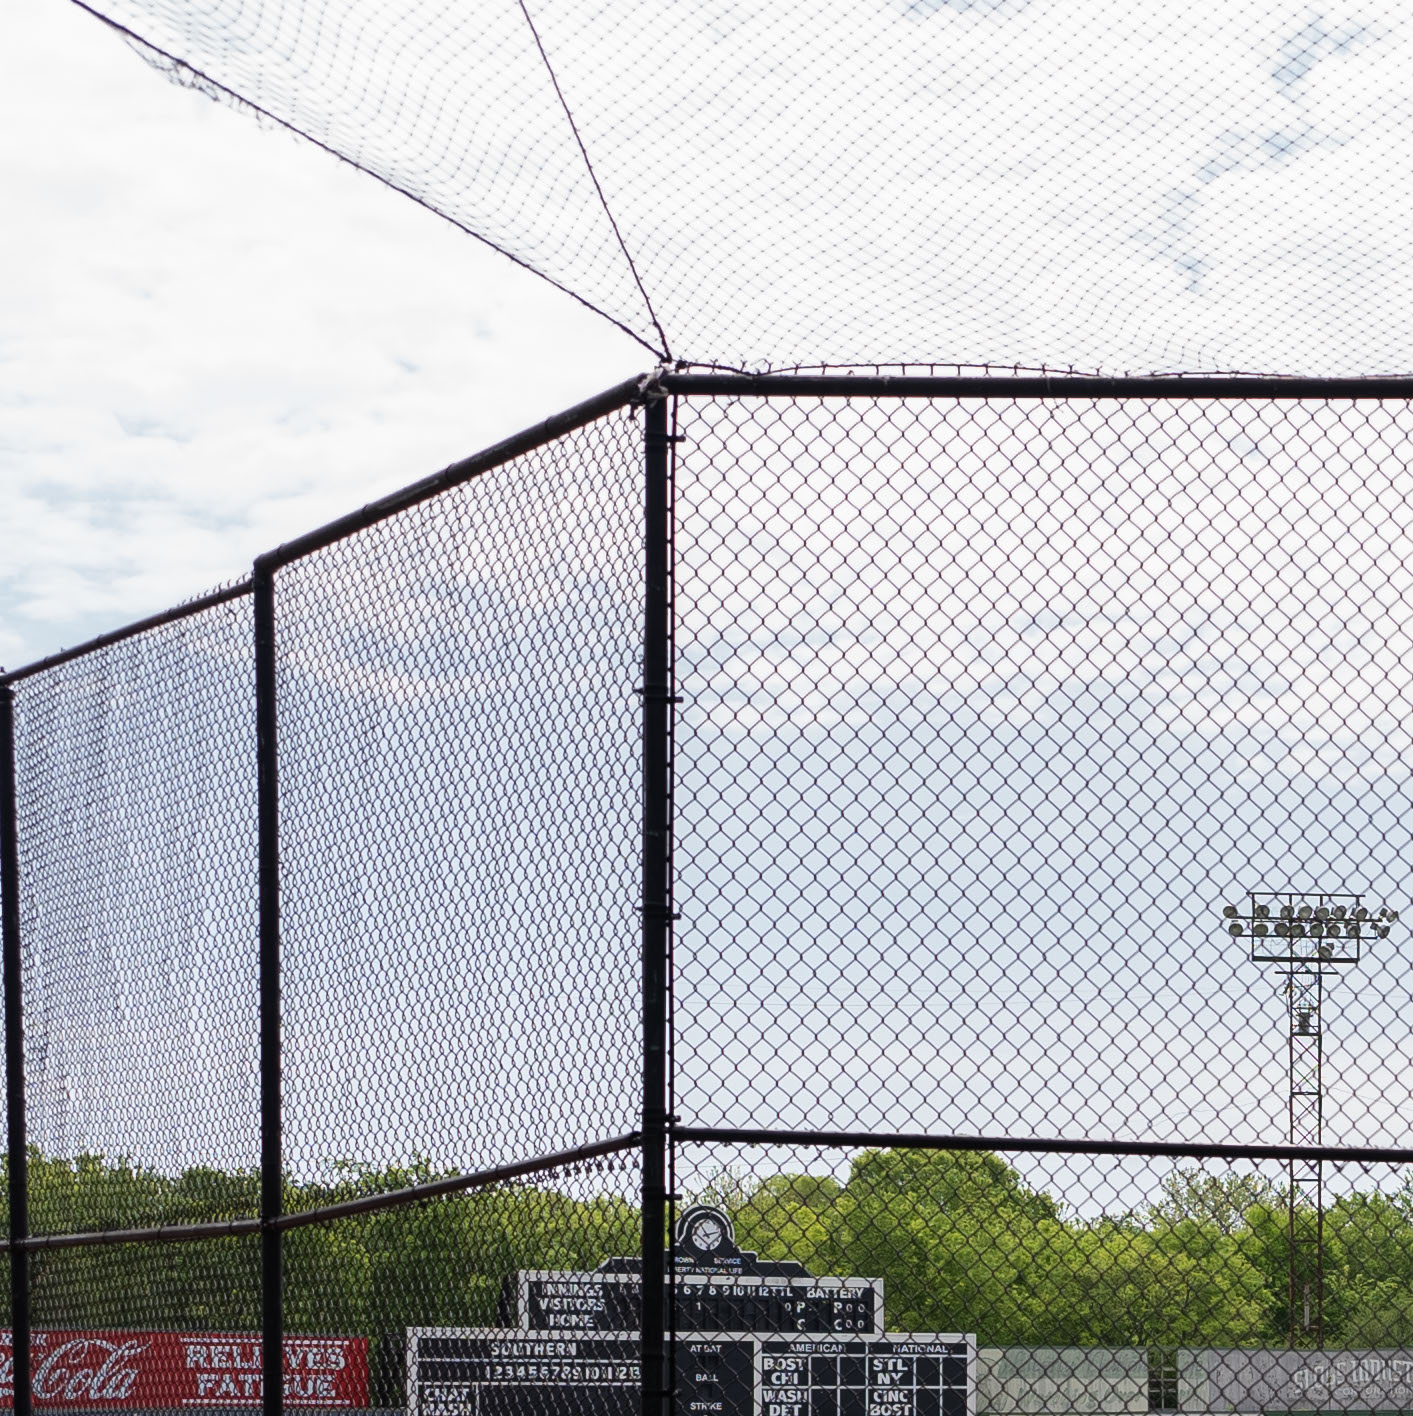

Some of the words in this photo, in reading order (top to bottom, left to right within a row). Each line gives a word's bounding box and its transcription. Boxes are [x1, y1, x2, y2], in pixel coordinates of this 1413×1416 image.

[541, 1283, 604, 1297] INNINGS
[806, 1287, 865, 1299] BATTERY
[538, 1297, 606, 1311] VISITORS
[549, 1314, 595, 1328] HOME
[490, 1342, 578, 1356] SOUTHERN
[689, 1344, 702, 1353] AT
[787, 1343, 846, 1353] AMERICAN
[892, 1343, 949, 1354] NATIONAL
[185, 1345, 346, 1371] RELIVES
[763, 1358, 806, 1371] BOST
[872, 1358, 909, 1371] STL
[695, 1373, 719, 1382] BALL
[770, 1372, 799, 1385] CHI
[877, 1372, 904, 1385] NY
[196, 1372, 336, 1397] FATIUE
[762, 1390, 808, 1403] WASH
[873, 1390, 909, 1403] CINC
[769, 1404, 803, 1416] DET
[869, 1403, 912, 1416] BOST
